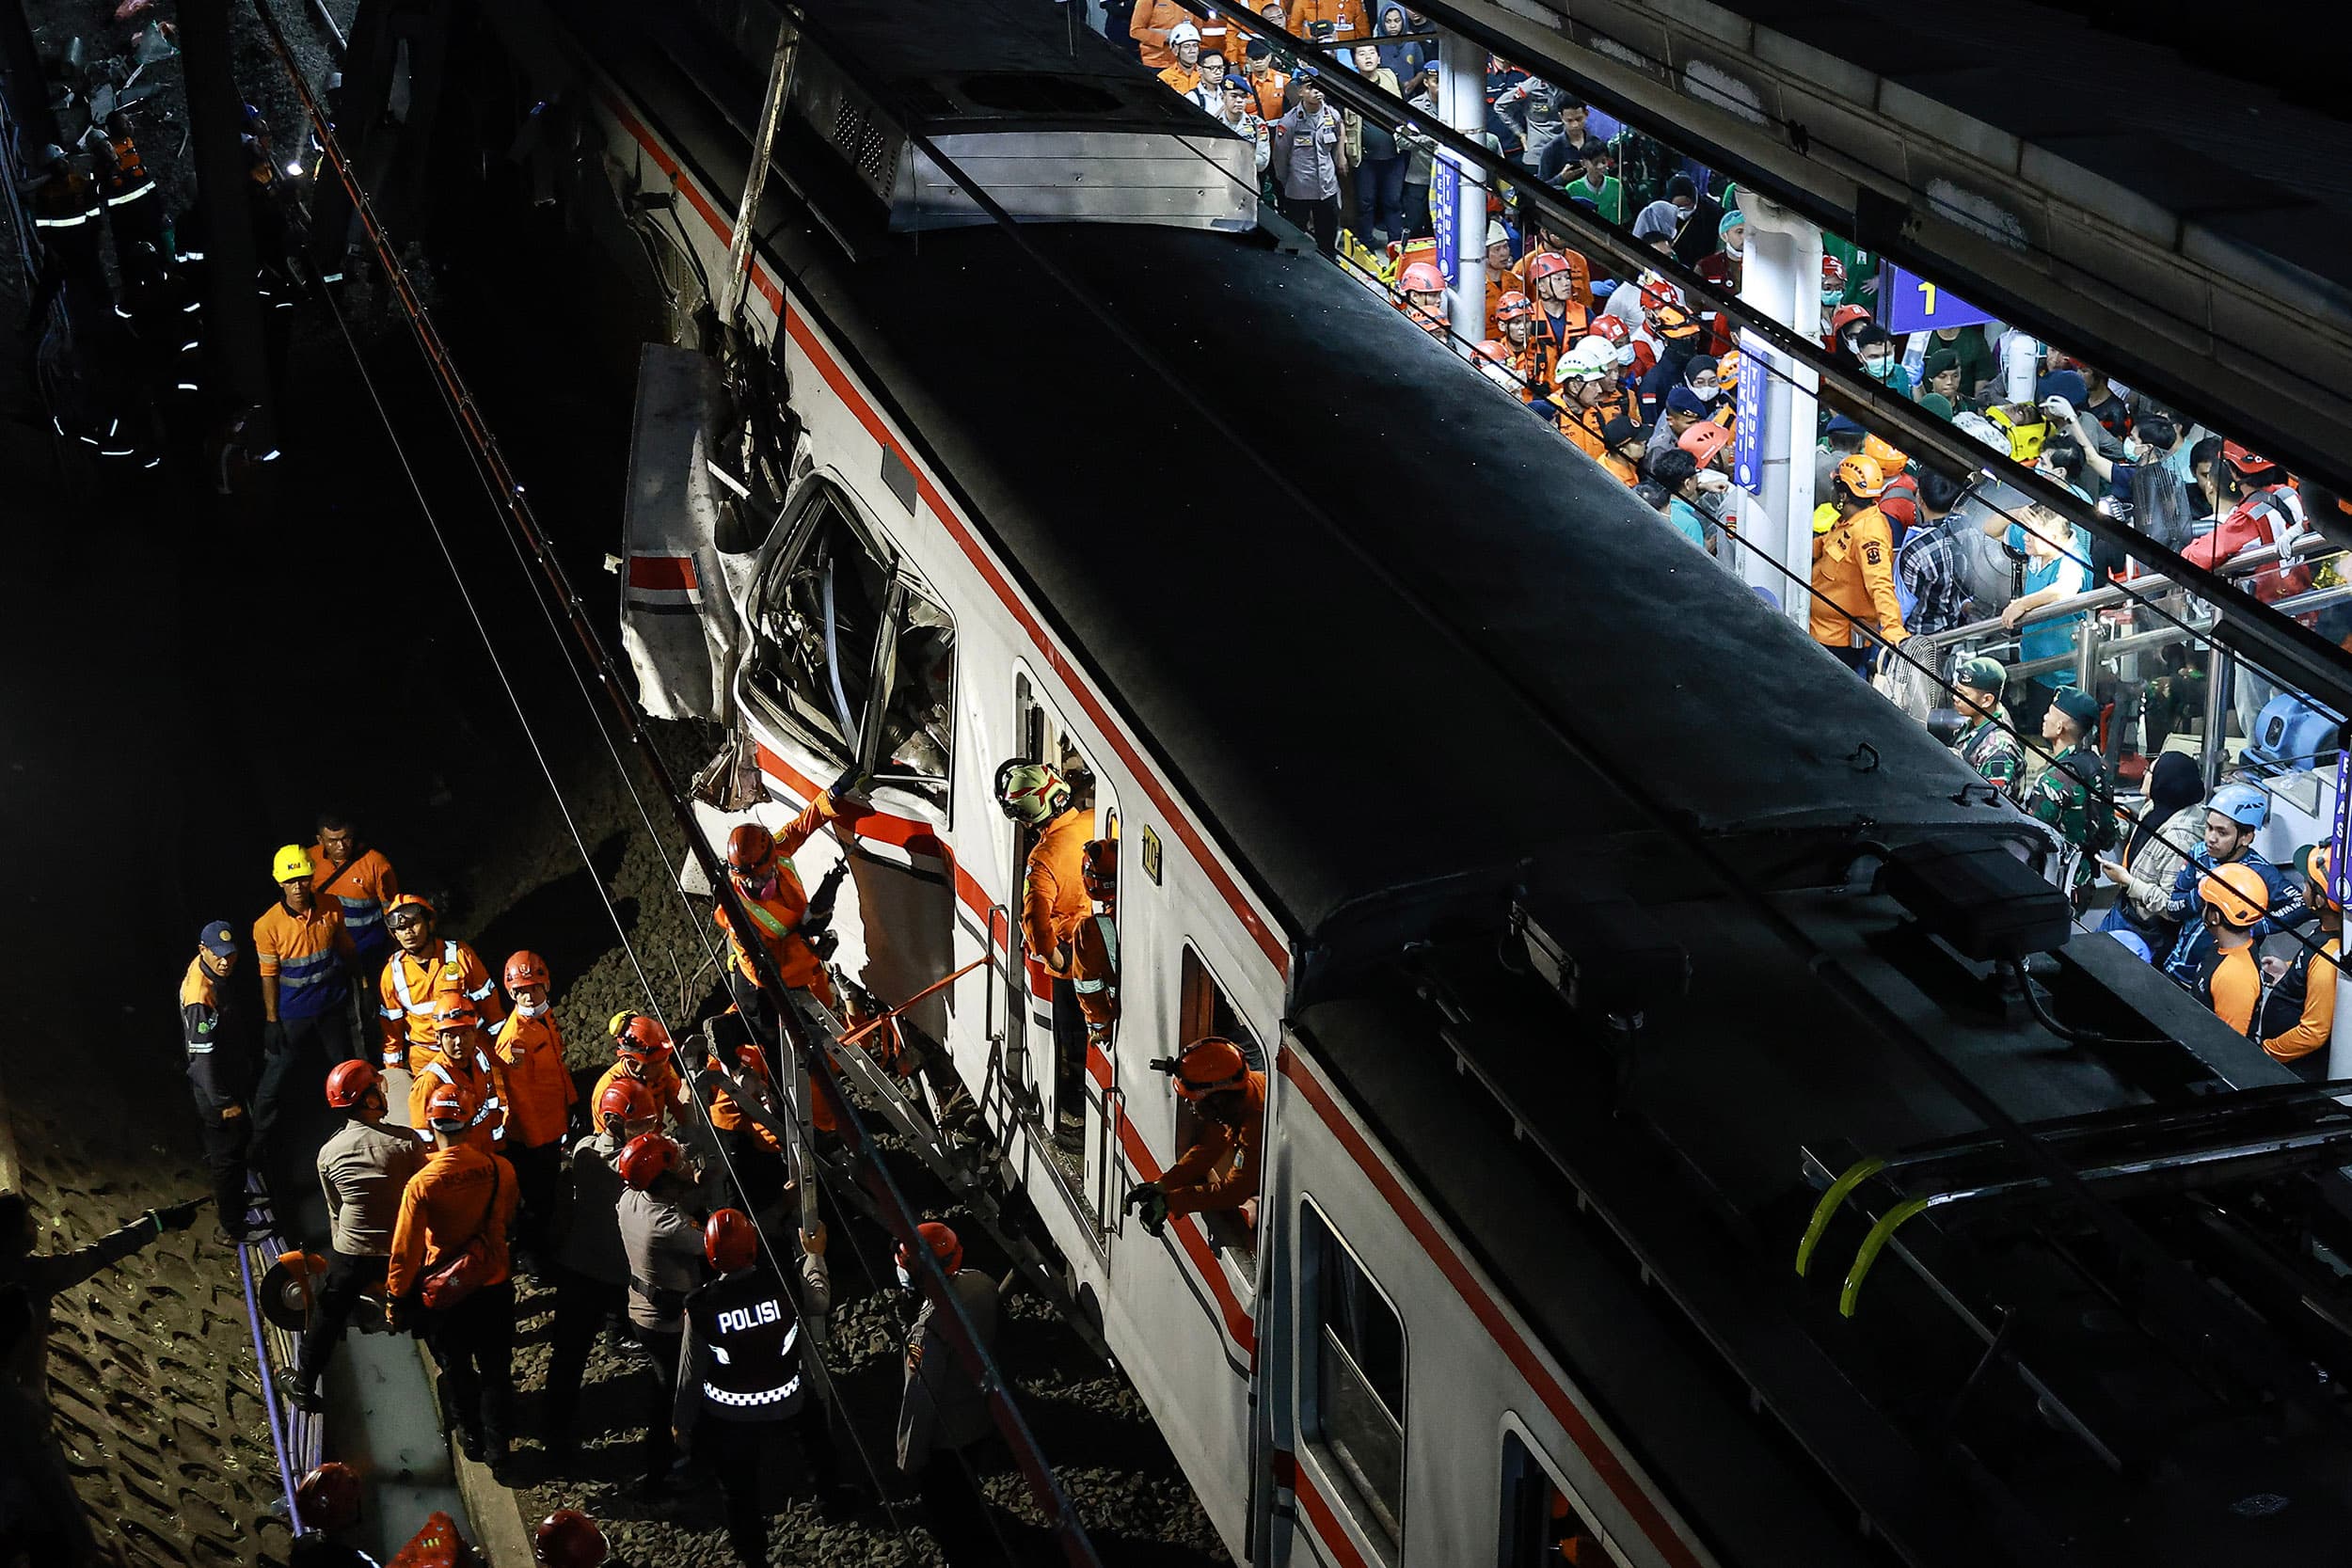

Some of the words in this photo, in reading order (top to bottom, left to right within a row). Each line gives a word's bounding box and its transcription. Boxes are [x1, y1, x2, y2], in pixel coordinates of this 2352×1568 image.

[1444, 174, 1453, 246] TIMUR
[1918, 281, 1936, 315] 1
[1738, 353, 1747, 452] BEKASI
[1748, 366, 1758, 451] TIMUR
[2336, 756, 2349, 860] EKASI
[718, 1299, 782, 1334] POLISI
